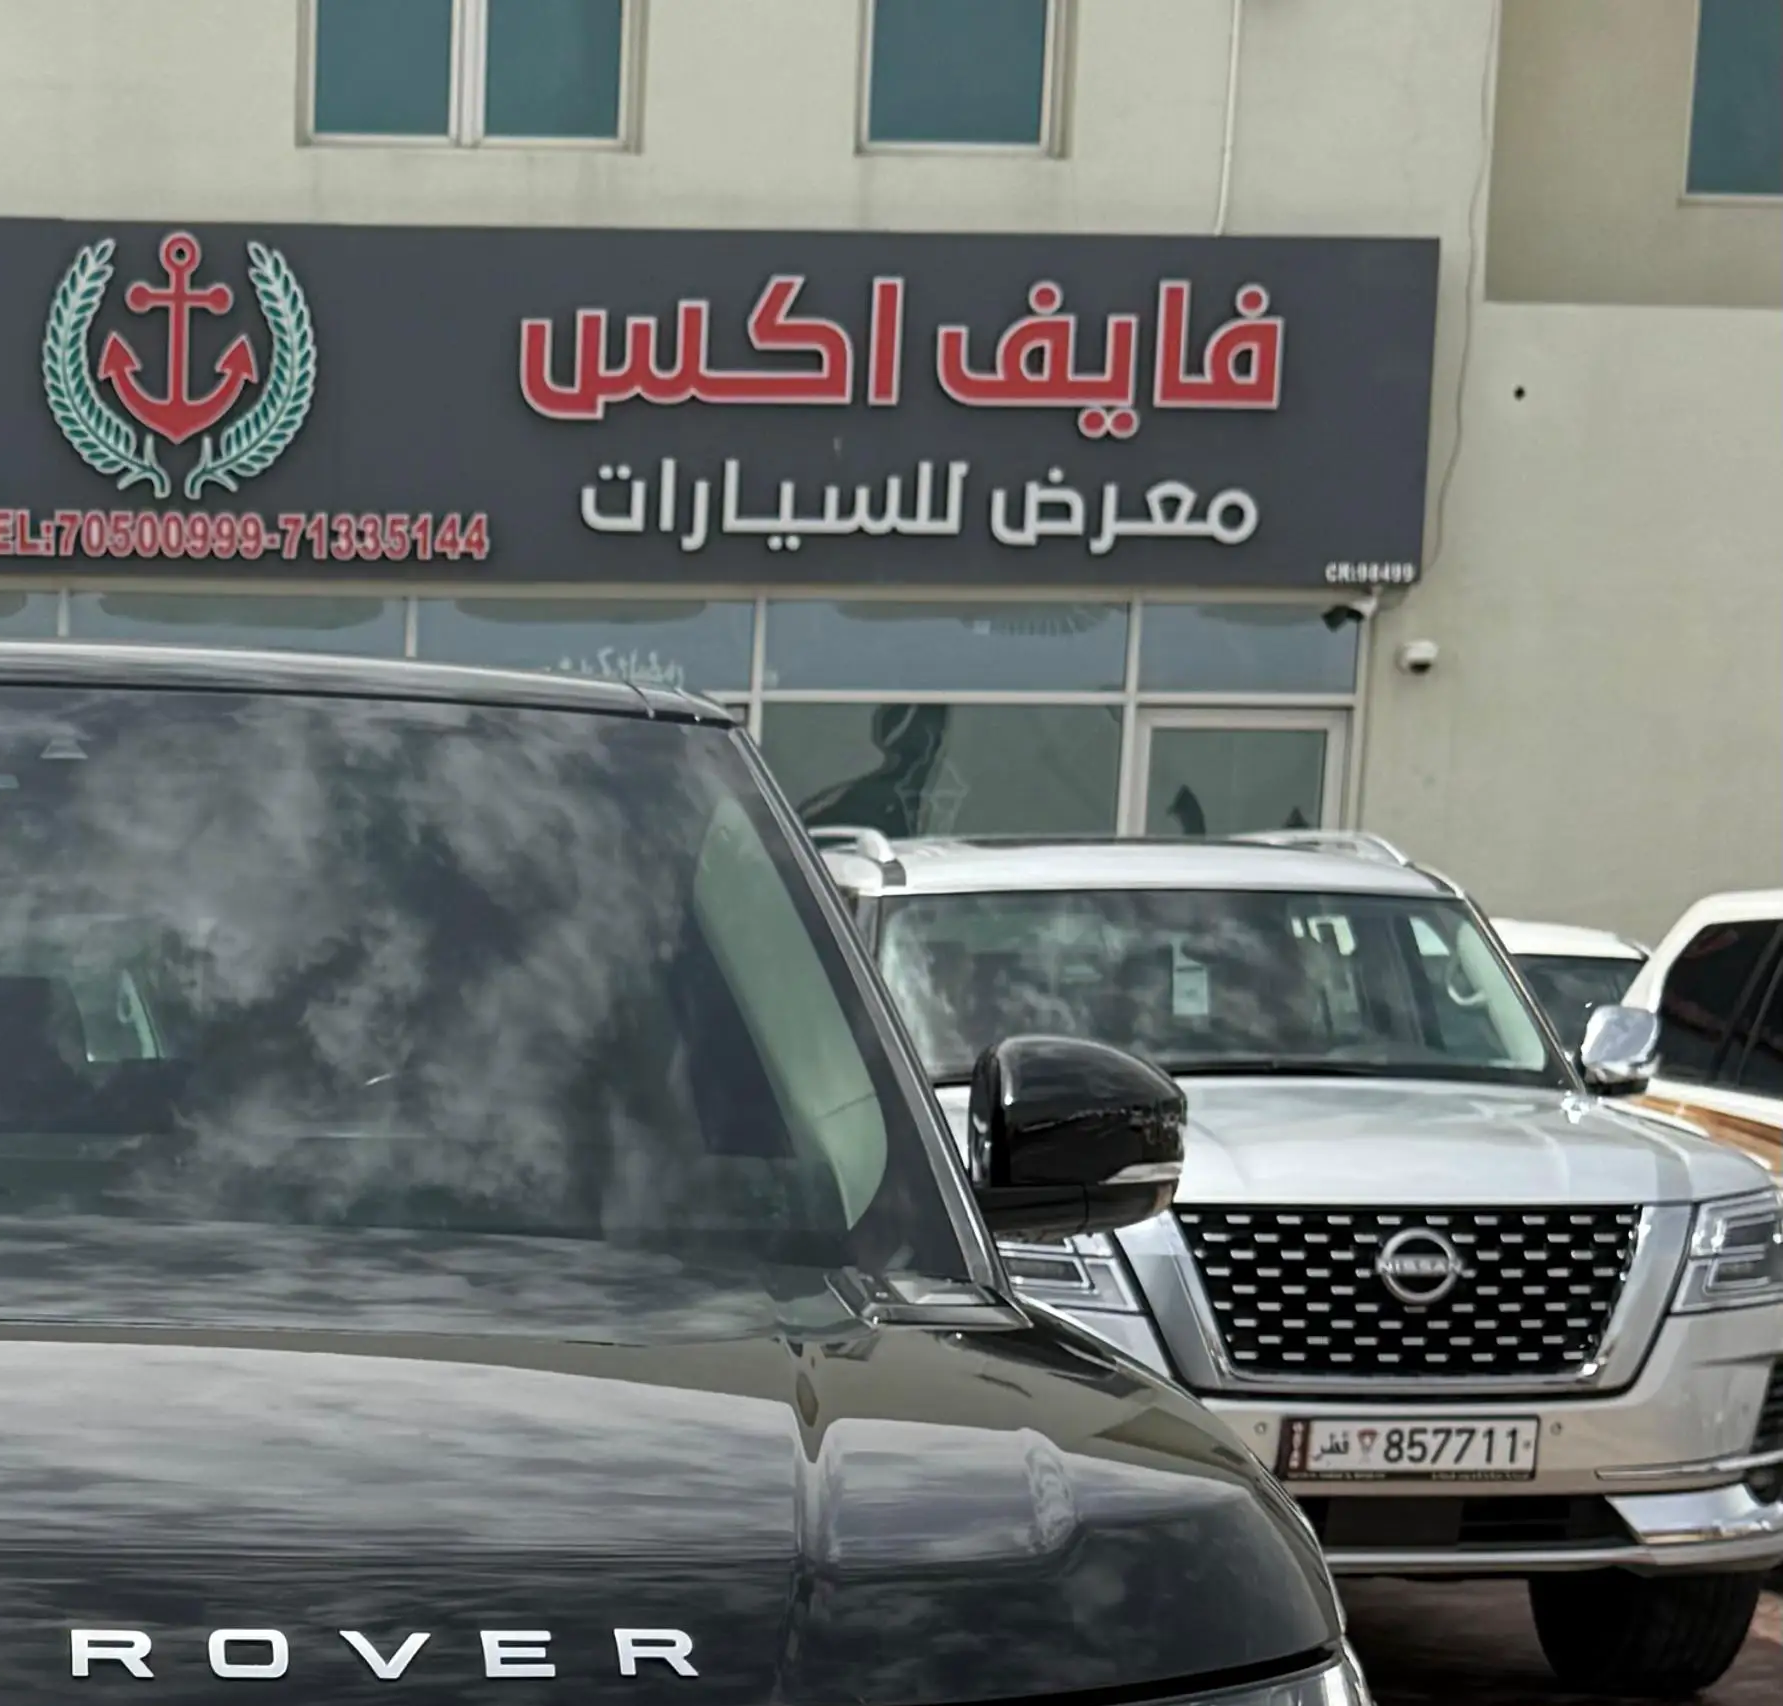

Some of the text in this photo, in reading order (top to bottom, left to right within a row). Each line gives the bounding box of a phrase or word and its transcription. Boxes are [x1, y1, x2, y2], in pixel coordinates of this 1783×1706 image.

[520, 275, 1284, 438] فايف اكس
[581, 458, 1258, 554] معرض للسيارات
[1383, 1427, 1519, 1464] 857711
[69, 1628, 700, 1680] ROVER
